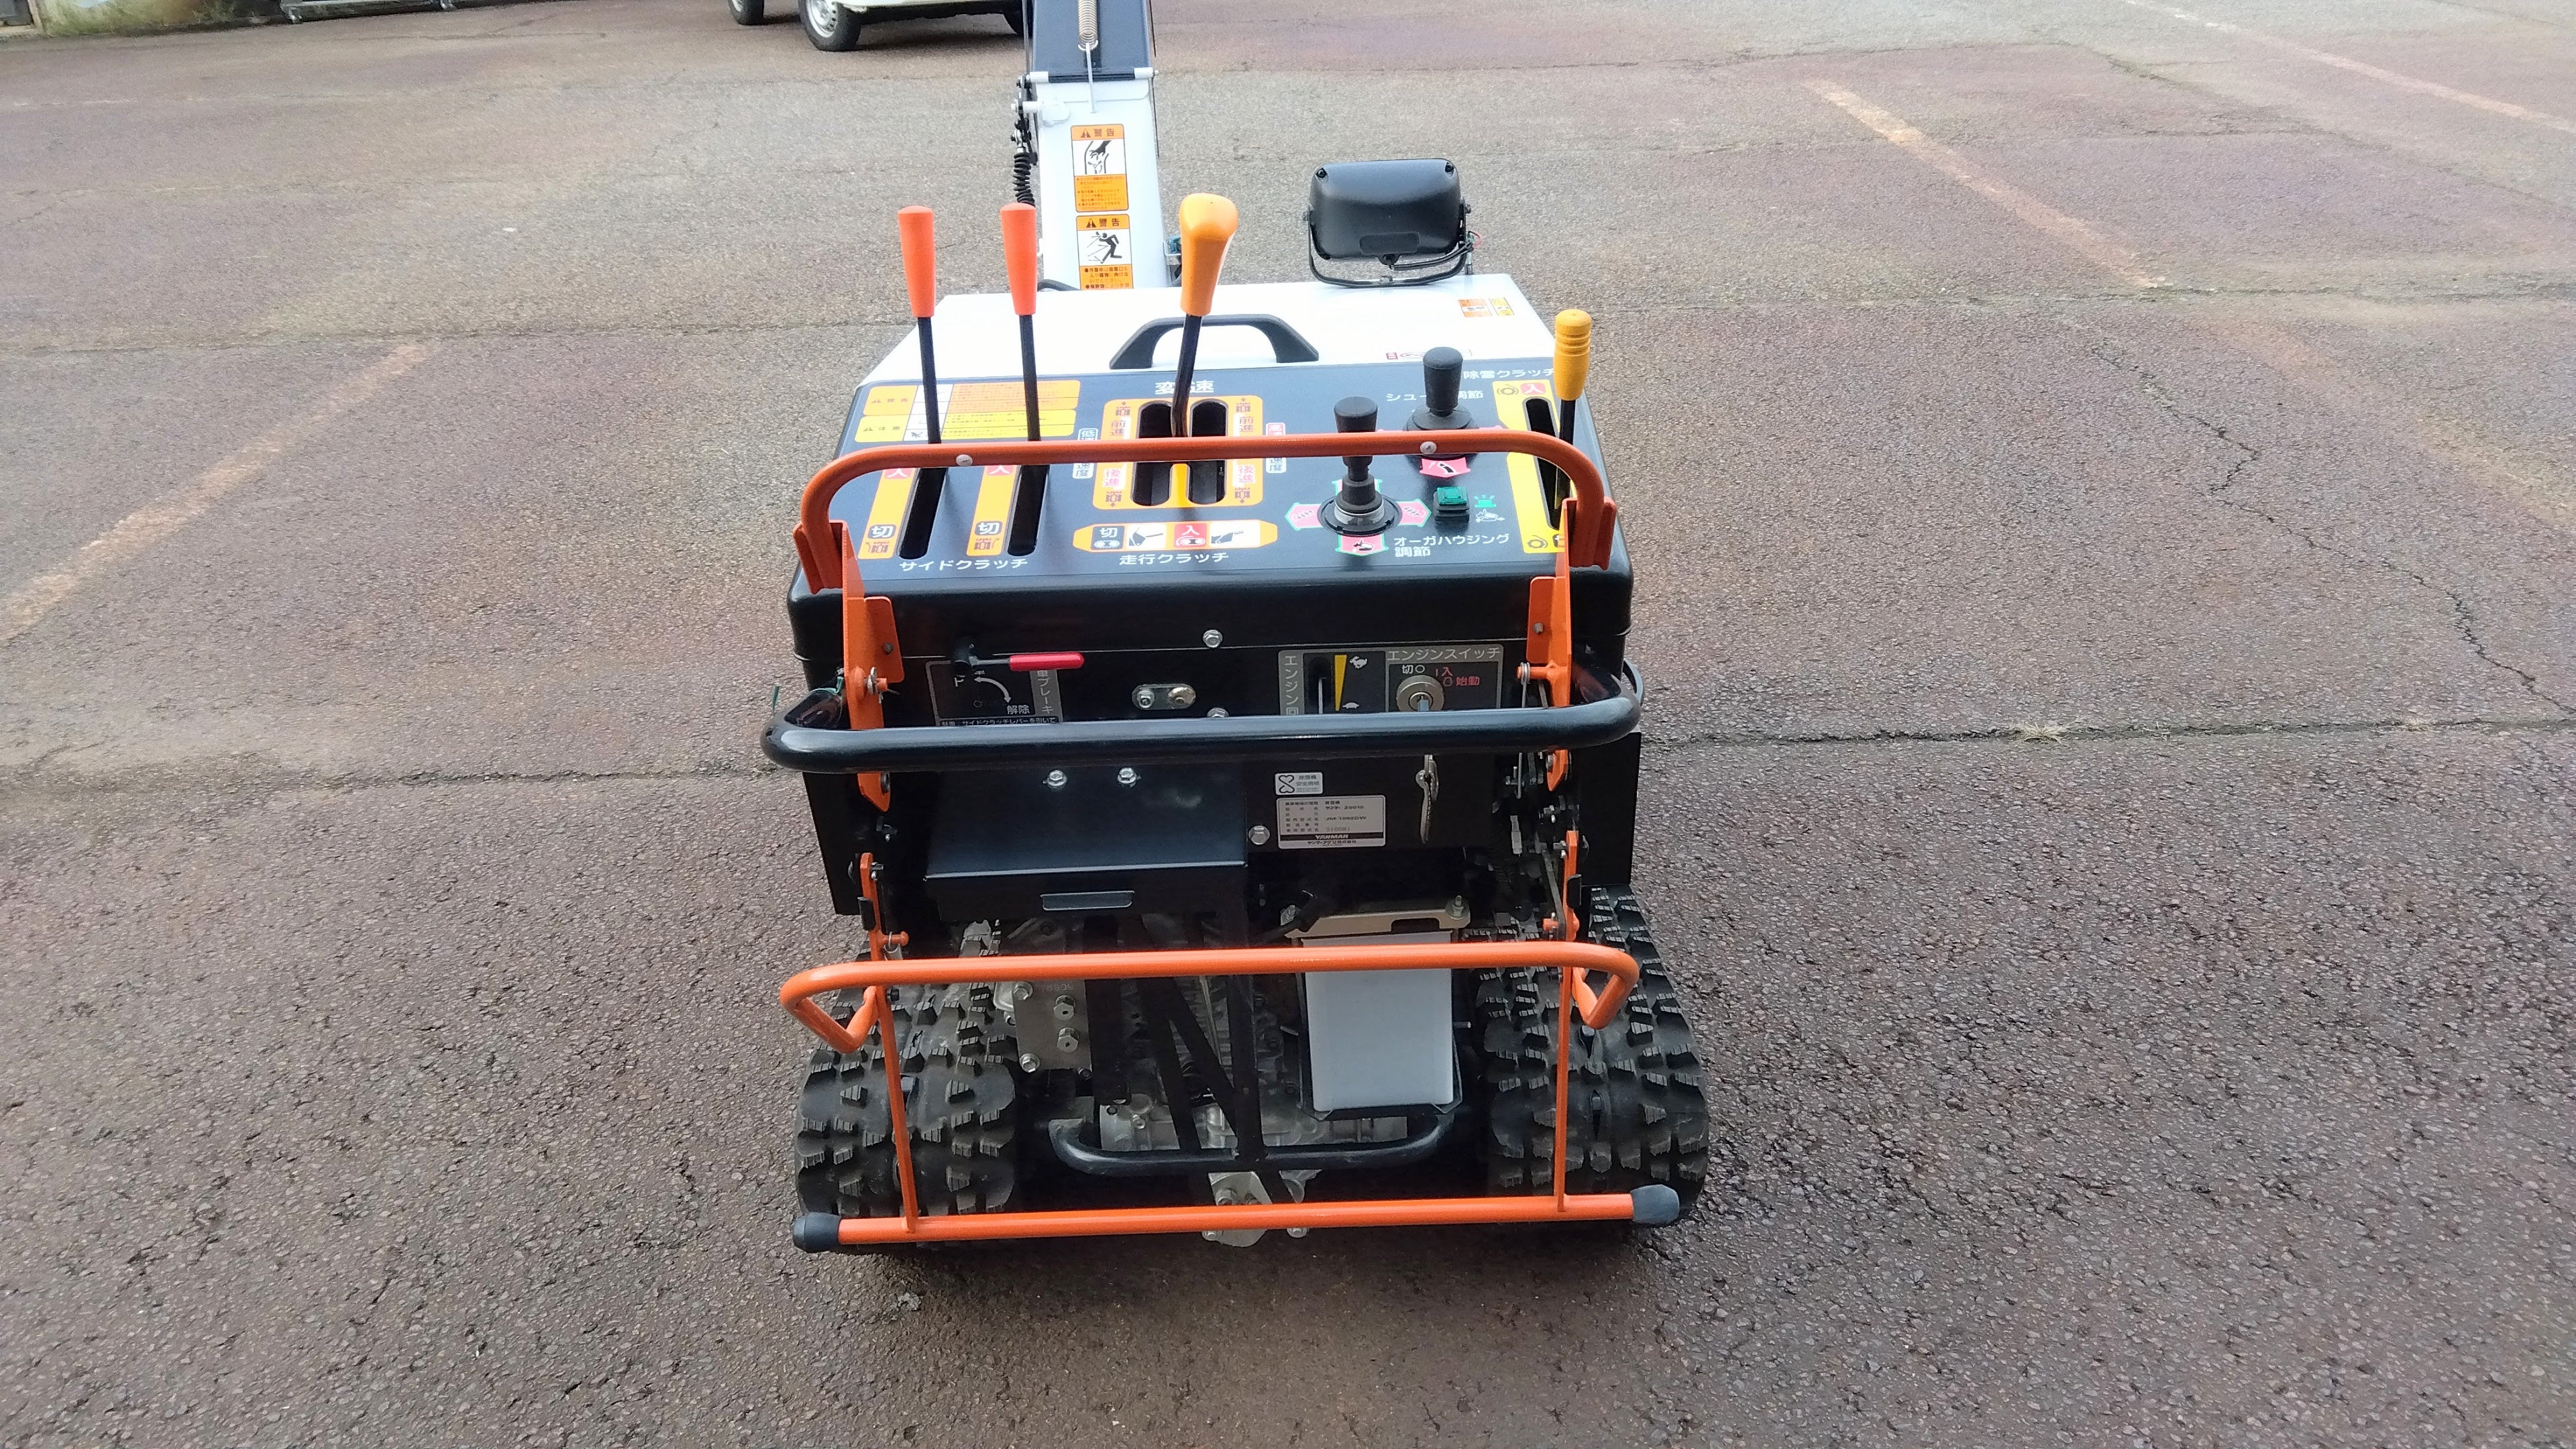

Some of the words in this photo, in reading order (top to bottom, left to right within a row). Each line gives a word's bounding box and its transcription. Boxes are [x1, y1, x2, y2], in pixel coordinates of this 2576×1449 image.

[1093, 128, 1115, 137] 警告
[1099, 217, 1120, 227] 警告
[1523, 383, 1544, 394] 入
[1103, 468, 1122, 486] 後進
[1238, 464, 1254, 483] 後進
[871, 525, 894, 538] 切
[977, 522, 1000, 535] 切
[1099, 527, 1118, 537] 切
[1181, 525, 1200, 535] 入
[1393, 533, 1509, 547] オーガハウジング
[1394, 545, 1431, 557] 調節
[1119, 552, 1229, 566] 走行クラッチ
[899, 558, 1028, 572] サイドクラッチ
[1387, 647, 1501, 661] エンジンスイッチ
[1401, 664, 1413, 675] 切
[1441, 666, 1454, 677] 入
[1456, 676, 1480, 687] 始動
[1007, 704, 1030, 715] 解除
